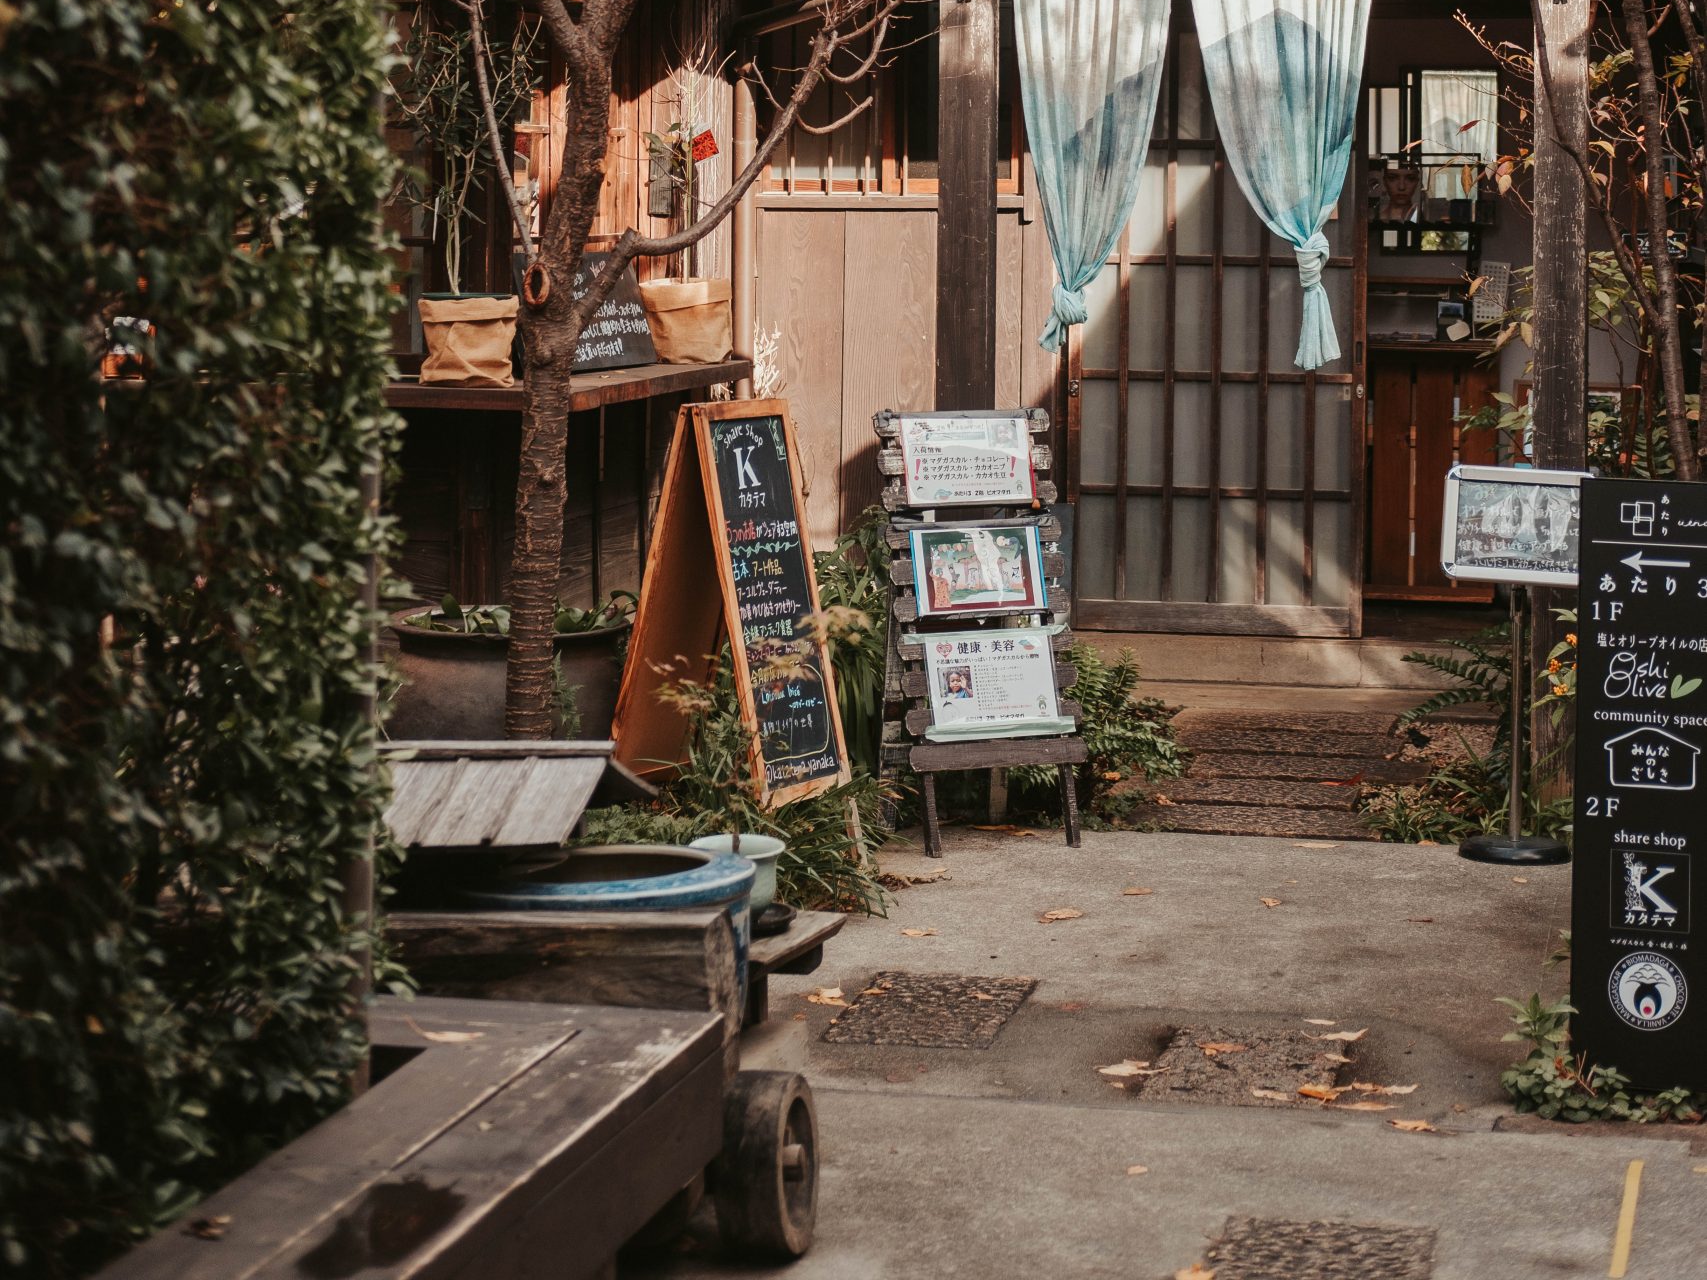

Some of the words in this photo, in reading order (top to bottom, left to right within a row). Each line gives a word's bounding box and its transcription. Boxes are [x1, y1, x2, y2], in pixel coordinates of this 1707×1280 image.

[733, 445, 762, 489] K
[739, 492, 766, 508] カタテマ
[1660, 493, 1671, 537] あたり
[1592, 601, 1624, 622] 1F
[957, 639, 1015, 655] 健康・美容
[1596, 631, 1707, 653] 塩とオリーブオイルの店
[1609, 651, 1671, 681] Oshi
[1604, 669, 1668, 700] Olive
[1594, 710, 1670, 727] community
[1631, 743, 1670, 758] みんな
[1646, 757, 1656, 767] の
[1631, 766, 1670, 784] ざしき
[1586, 797, 1620, 818] 2F
[1614, 830, 1650, 846] share
[1654, 832, 1686, 851] shop
[1623, 865, 1678, 915] K
[1624, 913, 1676, 928] カタテマ
[1625, 954, 1669, 969] BIOMADAGA
[1611, 970, 1632, 1021] MADAGASCAR
[1670, 975, 1685, 1019] CHOCOLATE
[1637, 1018, 1669, 1029] VANILLA
